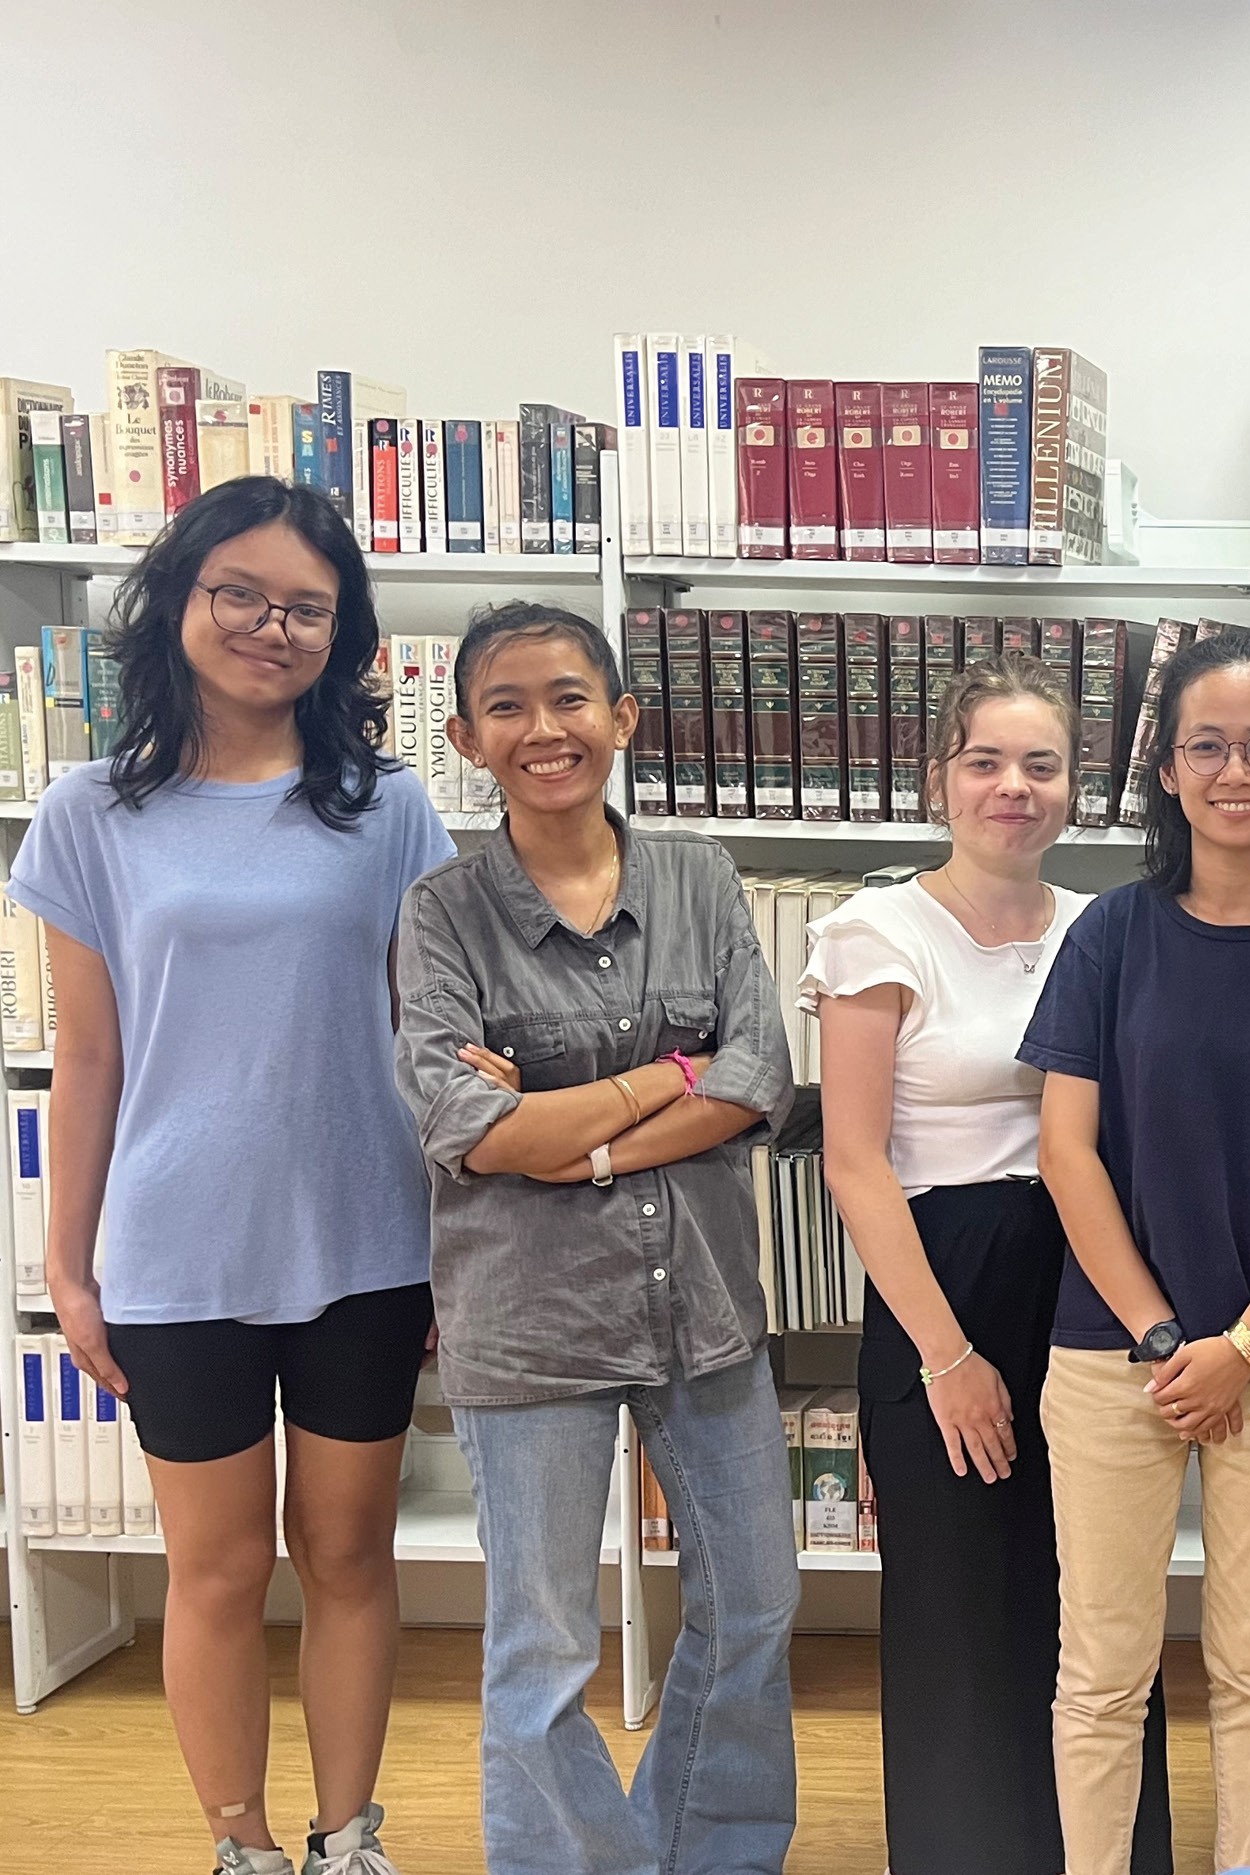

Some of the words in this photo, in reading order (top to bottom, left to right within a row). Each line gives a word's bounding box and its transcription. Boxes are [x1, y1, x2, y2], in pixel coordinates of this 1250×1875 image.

[982, 356, 1023, 365] LAROUSSE
[320, 374, 336, 426] RIMES
[334, 375, 344, 424] ASSONANCES
[624, 353, 637, 426] UNIVERSALIS
[660, 353, 669, 426] UNIVERSALIS
[691, 354, 702, 428] UNIVERSALIS
[718, 355, 729, 428] UNIVERSALIS
[753, 387, 763, 398] R
[803, 388, 813, 399] R
[852, 390, 861, 401] R
[900, 389, 910, 400] R
[948, 390, 958, 401] R
[116, 424, 157, 436] Bouquet
[164, 419, 177, 488] synonymes
[175, 419, 188, 475] nuances
[0, 950, 18, 1019] ROBERT
